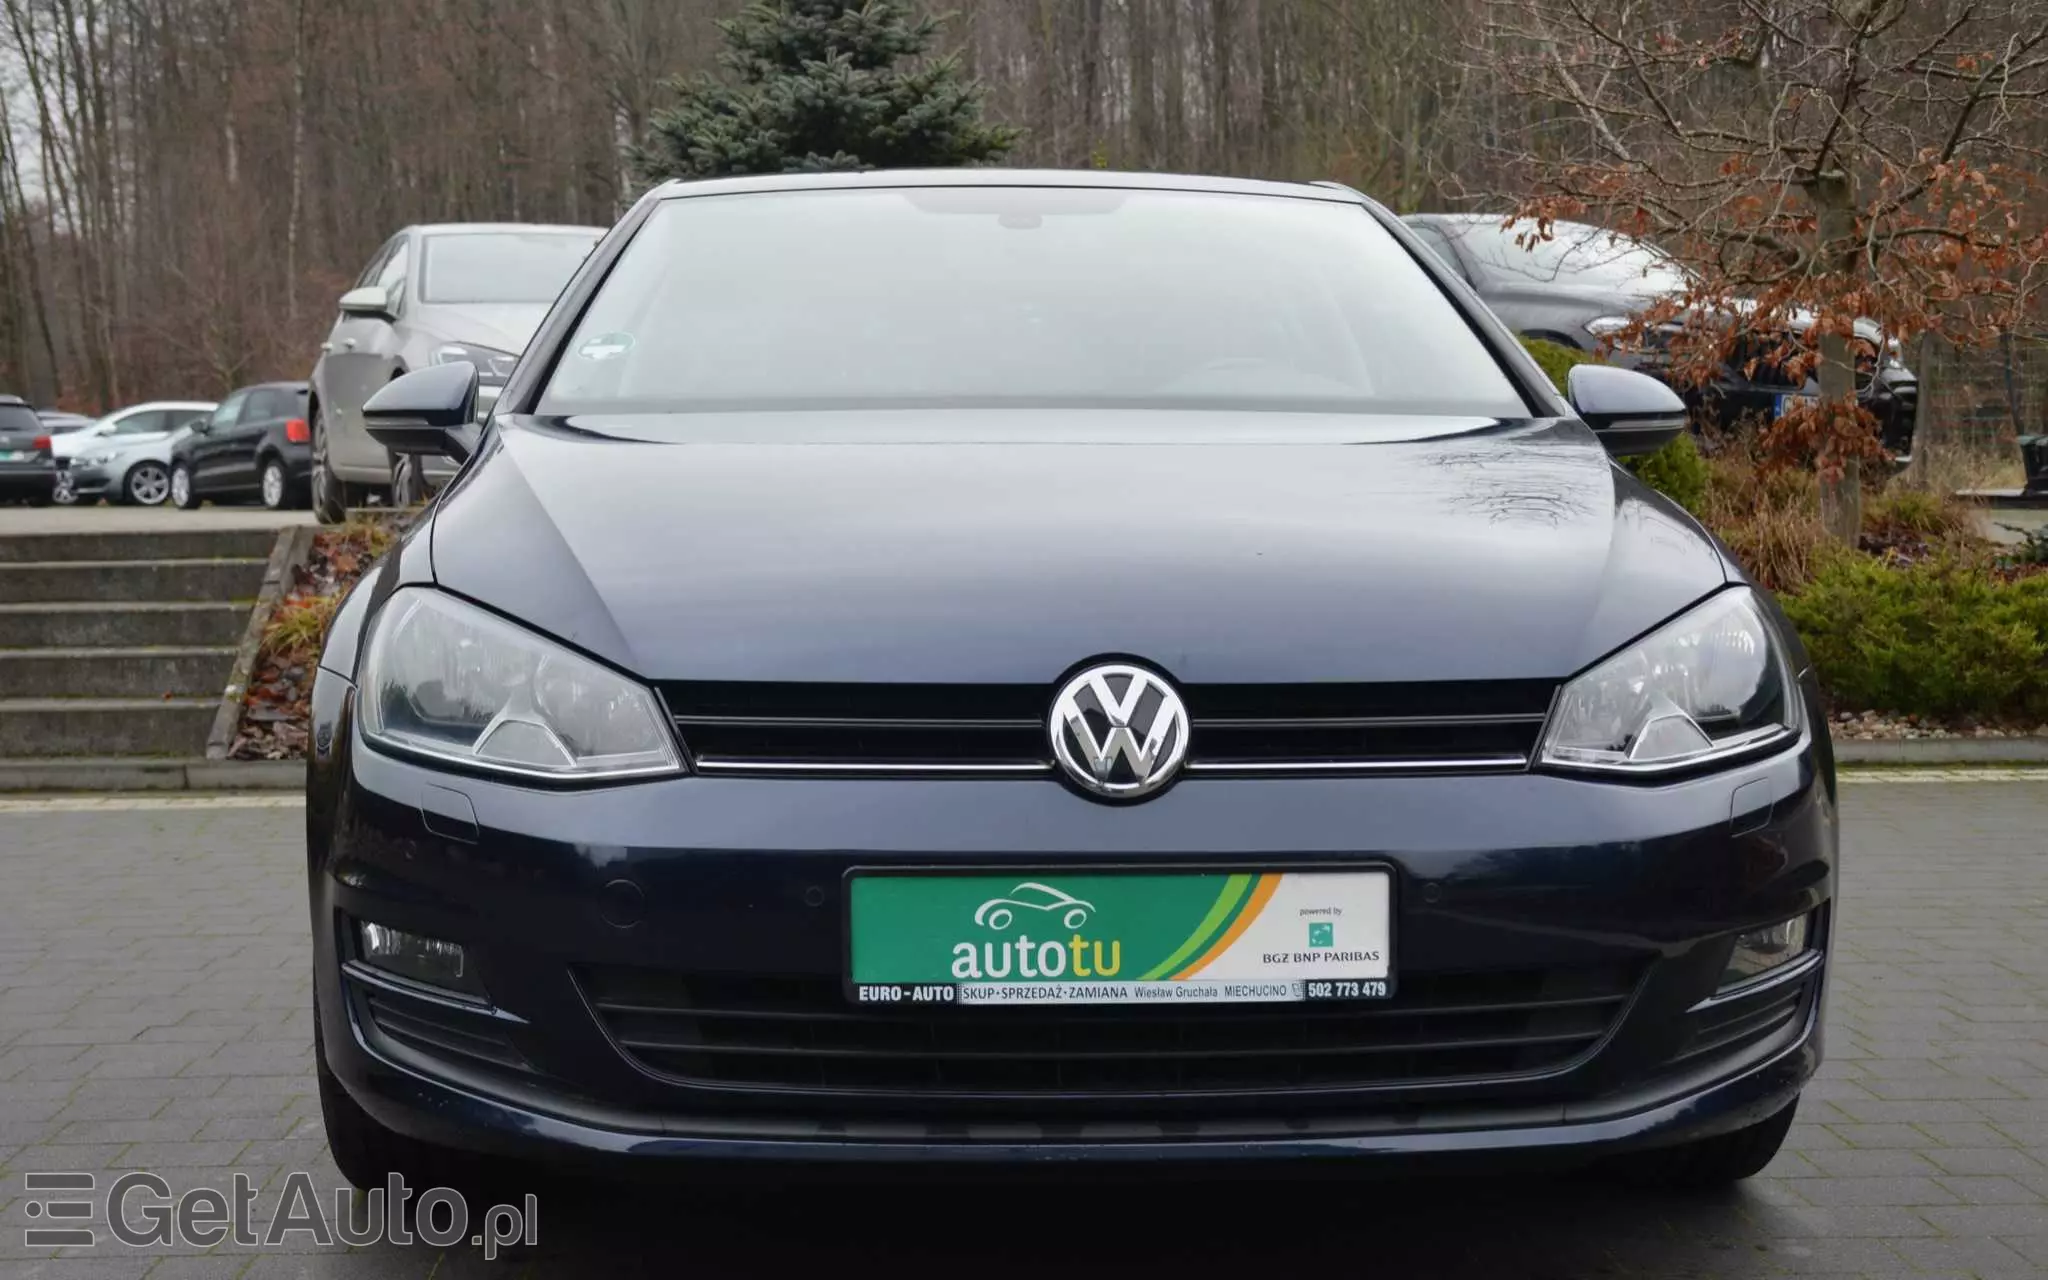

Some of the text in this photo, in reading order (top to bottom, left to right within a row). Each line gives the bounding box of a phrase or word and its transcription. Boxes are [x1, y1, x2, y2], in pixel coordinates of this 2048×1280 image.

[1299, 906, 1342, 917] powered by
[951, 934, 1121, 978] autotu
[1293, 951, 1321, 963] BNP
[1323, 950, 1380, 962] PARIBAS
[1224, 984, 1287, 997] MIECHUCINO
[1307, 982, 1332, 997] 502
[1335, 982, 1359, 996] 773
[1362, 981, 1387, 996] 479
